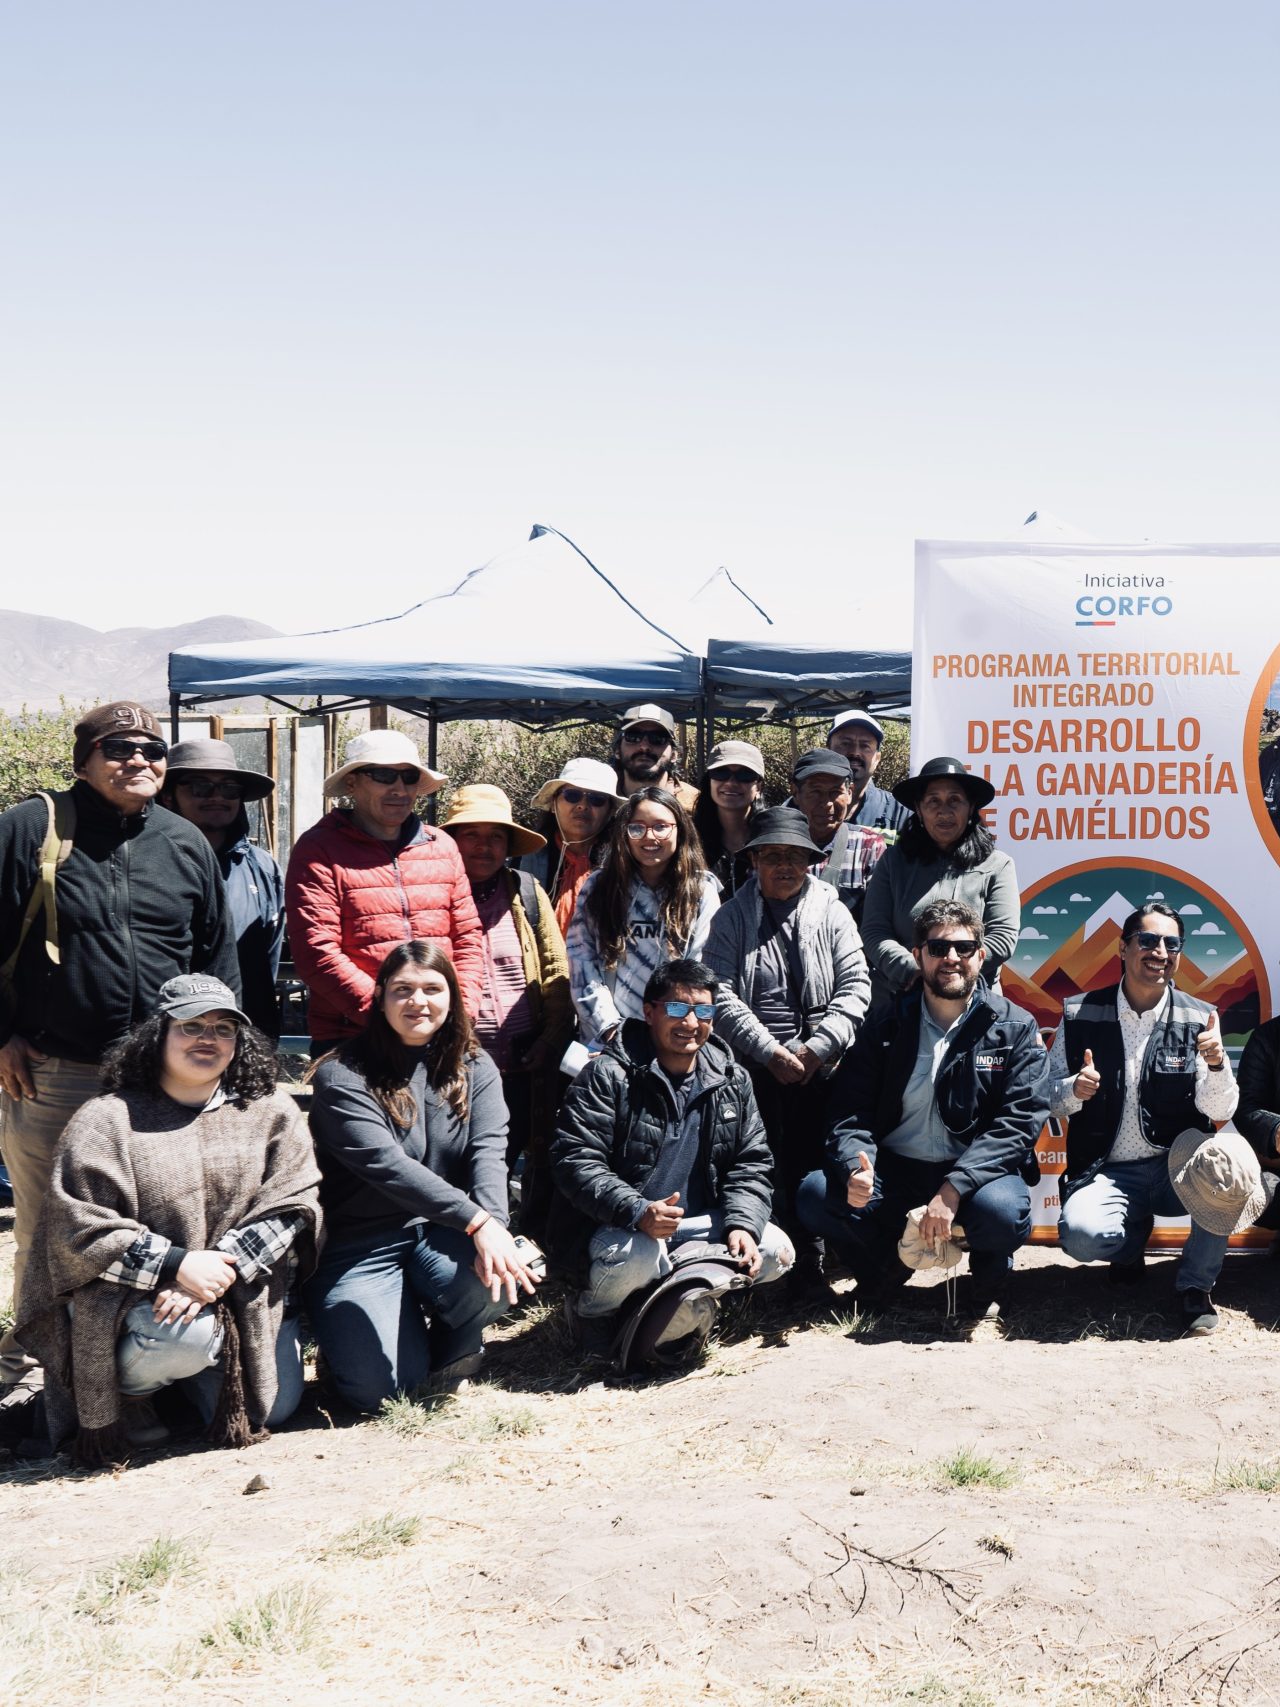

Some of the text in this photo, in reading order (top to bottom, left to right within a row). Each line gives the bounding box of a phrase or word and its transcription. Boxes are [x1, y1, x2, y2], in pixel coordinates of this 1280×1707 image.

[1084, 573, 1165, 588] Iniciativa
[1075, 595, 1173, 616] CORFO
[932, 652, 1241, 678] PROGRAMA TERRITORIAL
[1012, 682, 1154, 708] INTEGRADO
[966, 717, 1201, 754] DESARROLLO
[1036, 753, 1239, 797] GANADERÍA
[1008, 799, 1211, 841] CAMÉLIDOS
[976, 1055, 1004, 1066] INDAP
